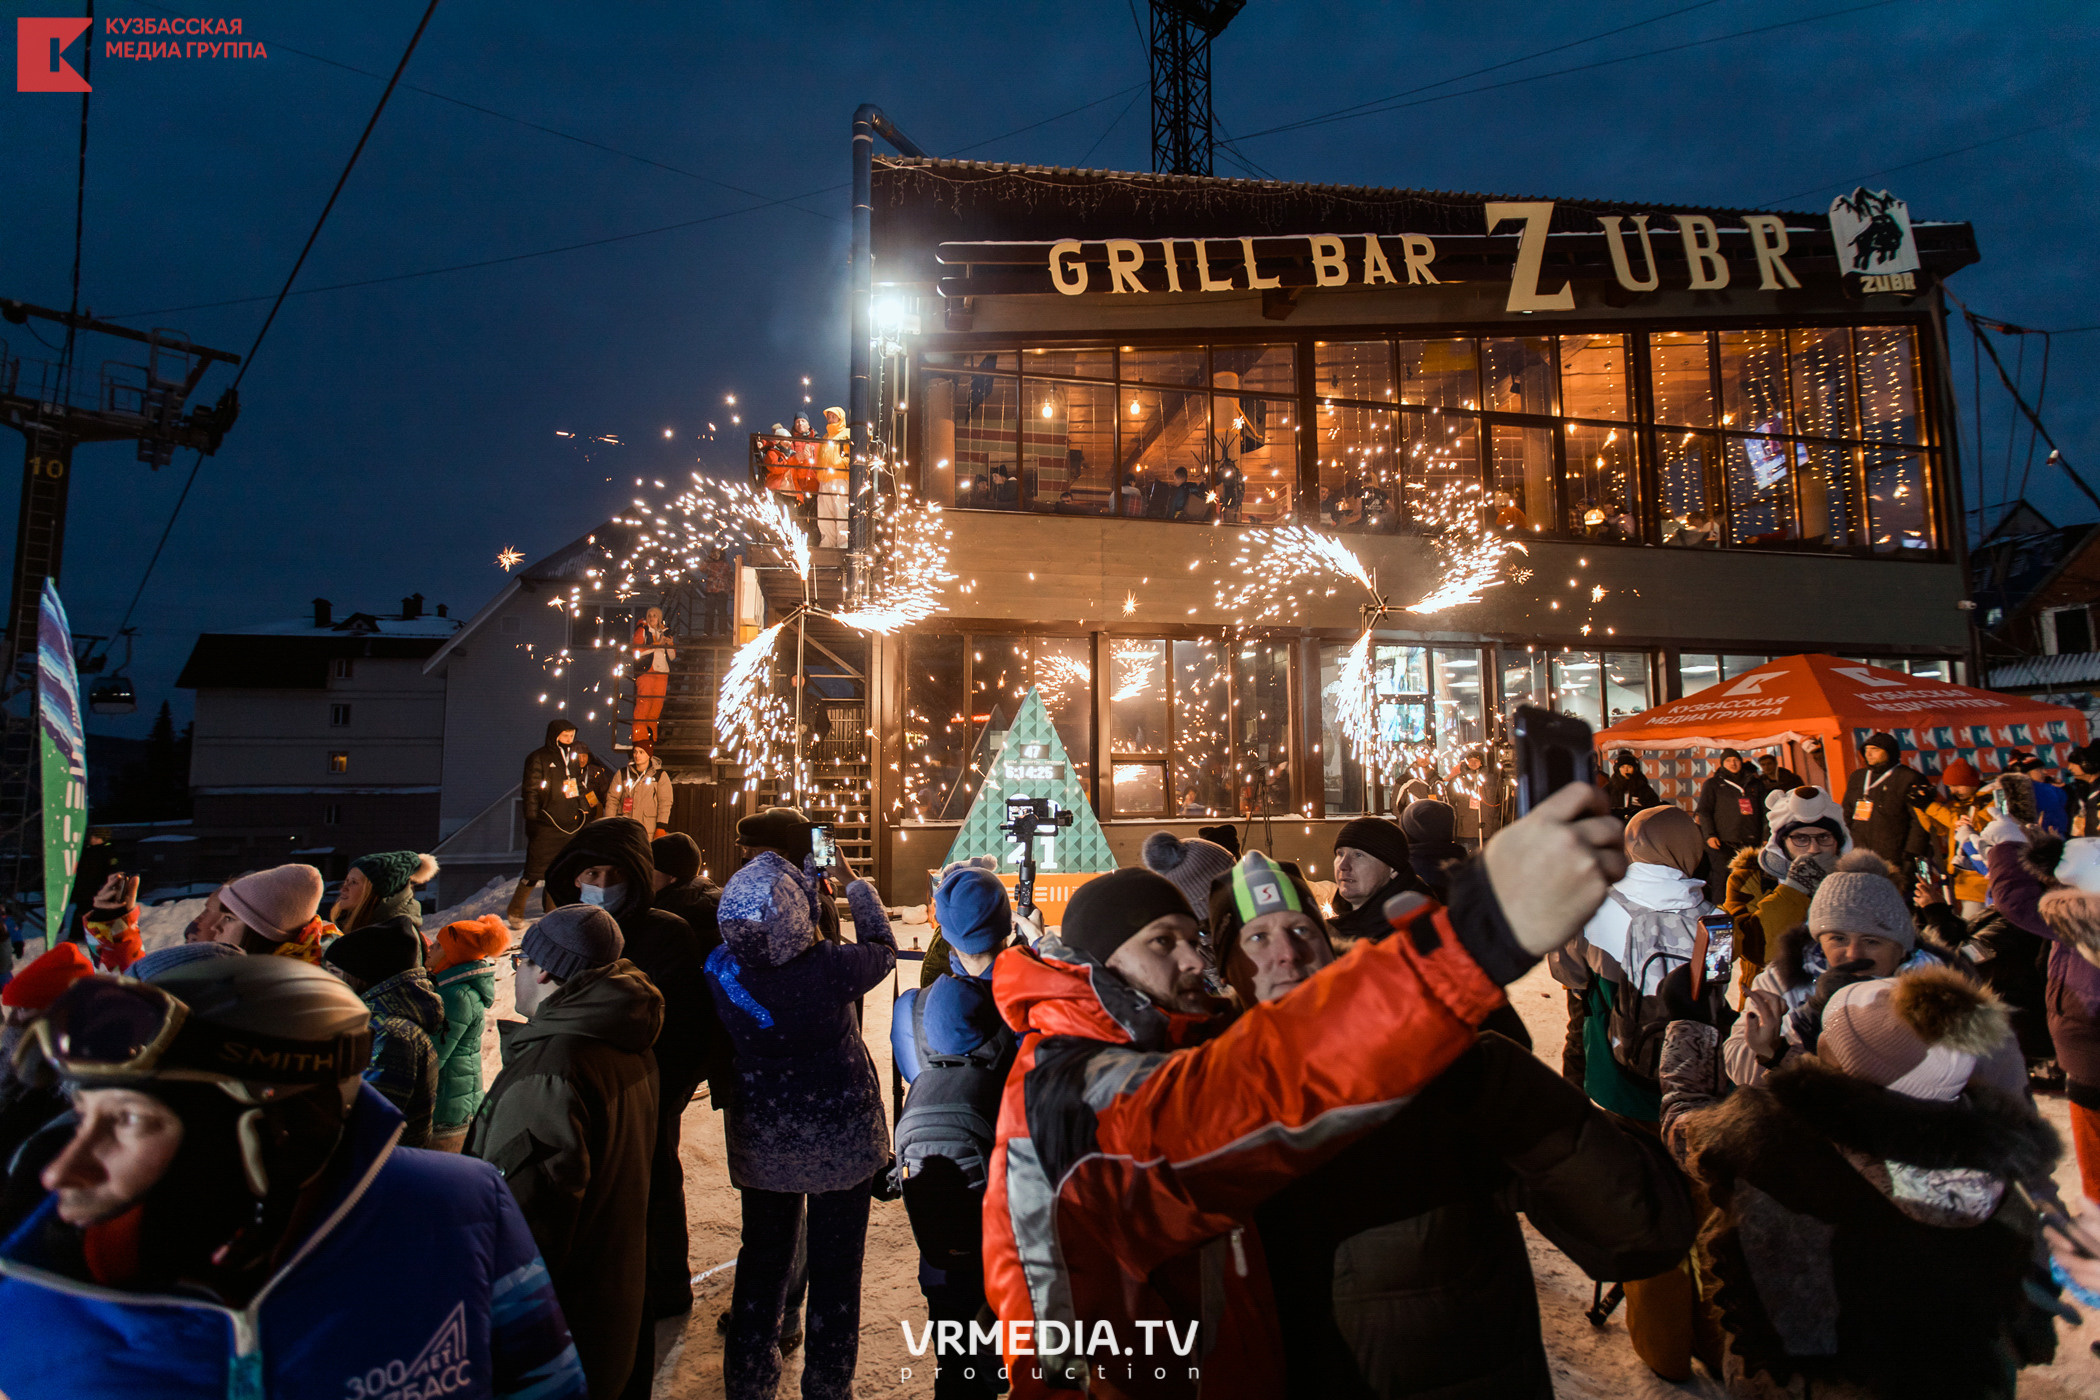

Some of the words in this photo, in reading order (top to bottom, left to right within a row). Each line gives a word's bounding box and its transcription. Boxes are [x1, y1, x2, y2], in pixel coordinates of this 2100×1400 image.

[1048, 237, 1280, 296] GRILL
[1309, 232, 1441, 286] BAR
[1485, 201, 1802, 313] ZUBR
[1860, 272, 1916, 293] ZUBR
[29, 456, 64, 478] 10
[1668, 696, 1790, 714] КУЗБАССКАЯ
[1854, 688, 1973, 701] КУЗБАССКАЯ
[1645, 712, 1706, 725] МЕДИА
[1708, 707, 1783, 721] ГРУППА
[217, 1040, 335, 1072] SMITH
[345, 1359, 406, 1400] 300
